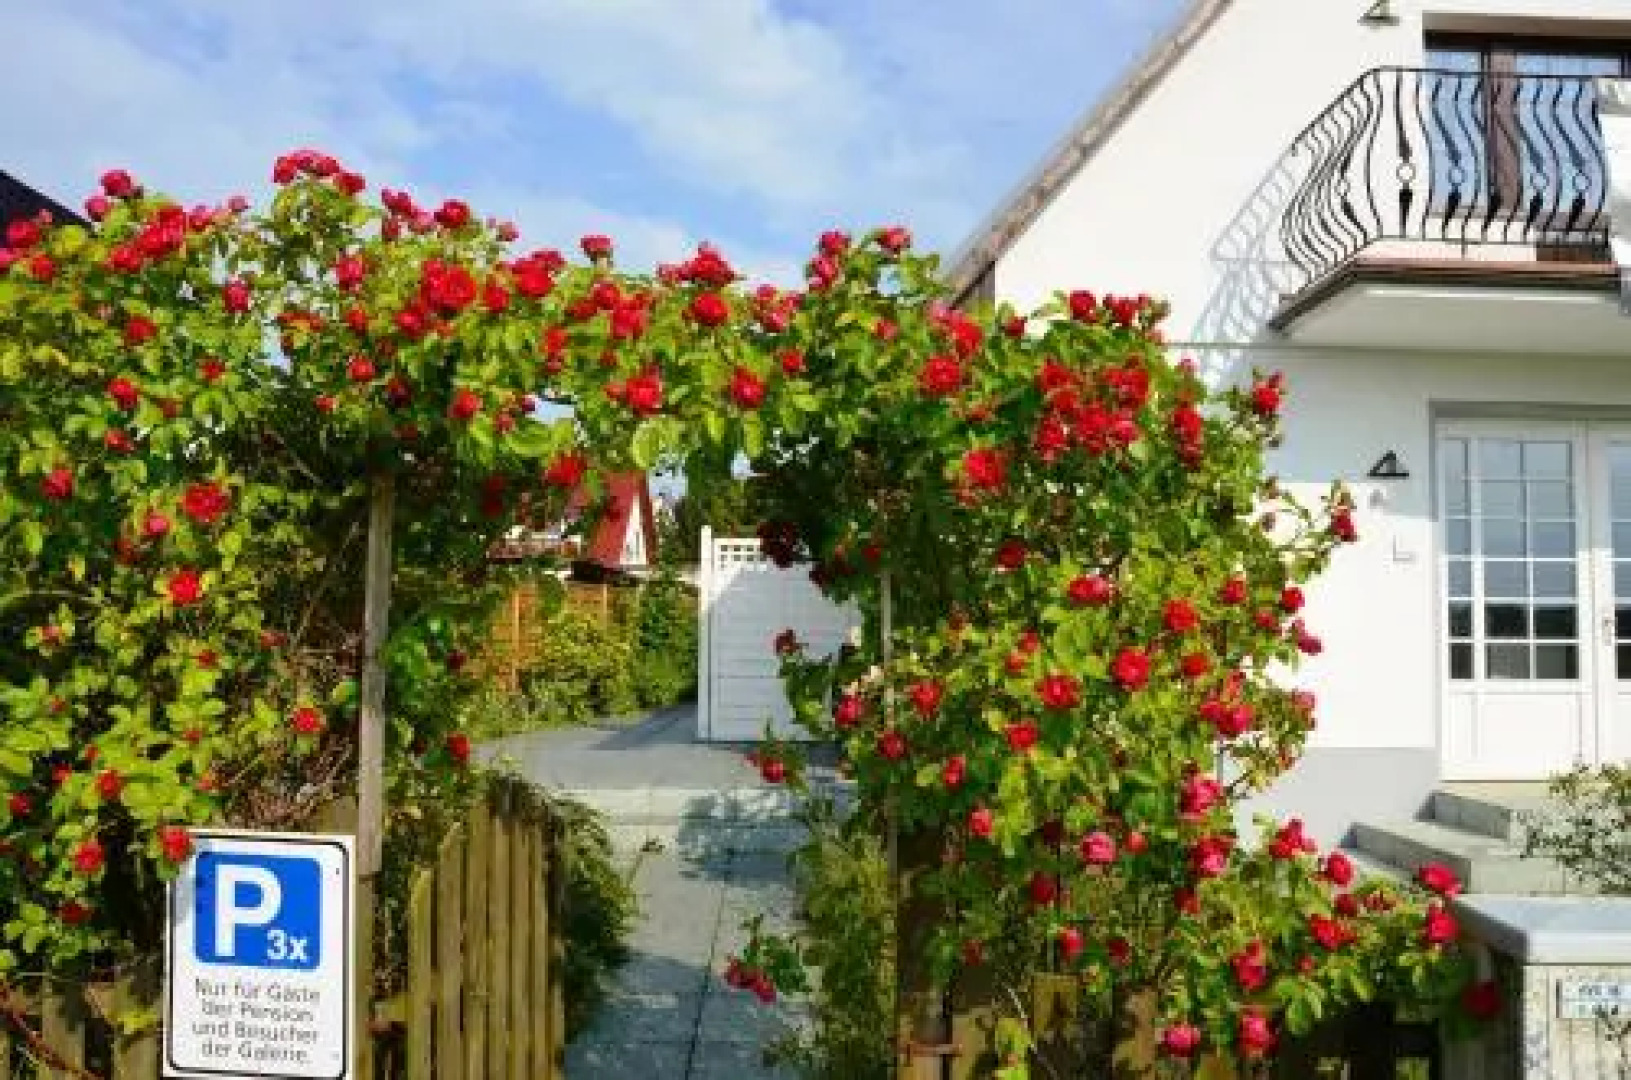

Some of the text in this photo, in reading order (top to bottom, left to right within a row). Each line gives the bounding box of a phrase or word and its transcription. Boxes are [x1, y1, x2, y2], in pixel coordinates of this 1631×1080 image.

[215, 864, 281, 957] P
[266, 929, 307, 961] 3x
[195, 978, 226, 997] Nur
[192, 1020, 229, 1037] und
[201, 1039, 232, 1058] der
